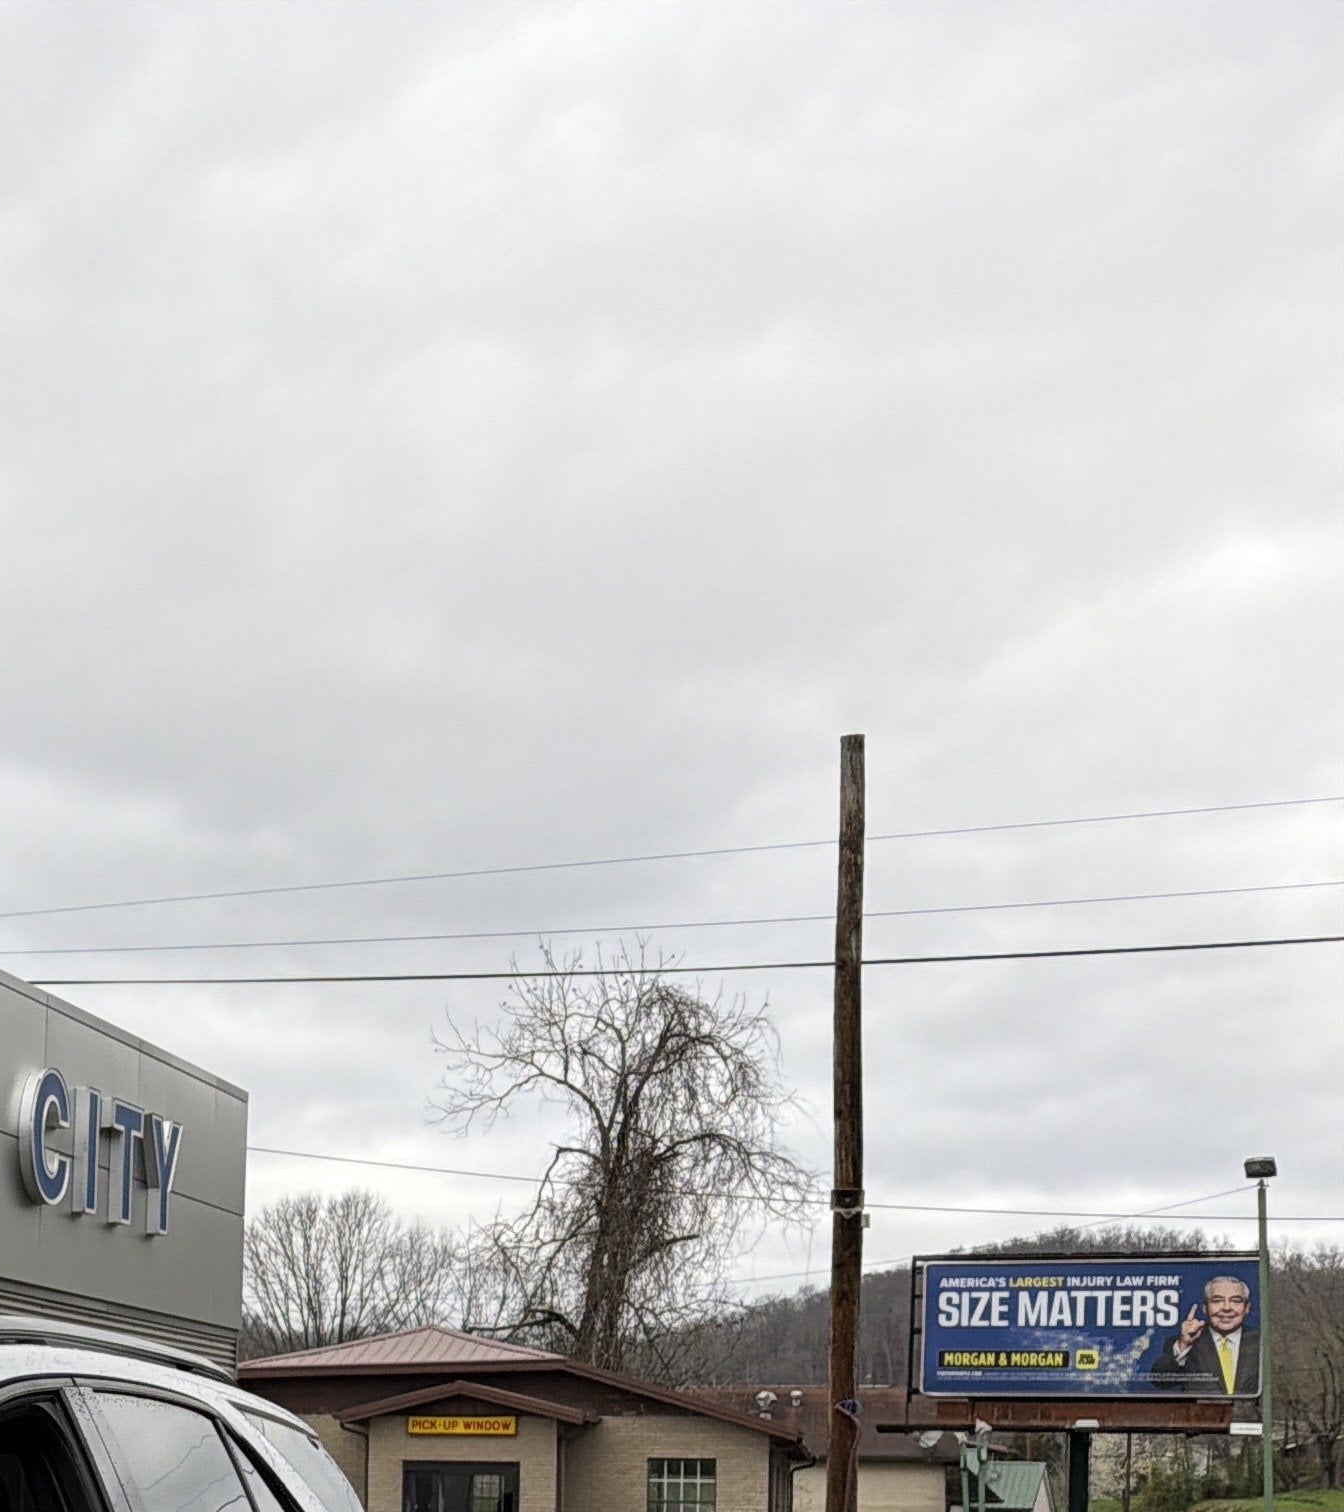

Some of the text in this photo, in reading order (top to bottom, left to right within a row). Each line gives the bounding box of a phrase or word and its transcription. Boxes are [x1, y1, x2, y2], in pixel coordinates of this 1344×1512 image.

[17, 1066, 184, 1237] CITY
[939, 1275, 1180, 1288] AMERICA'S LARGEST INJURY LAW FIRM
[938, 1289, 1180, 1327] SIZE MATTERS
[943, 1352, 996, 1366] MORGAN
[998, 1352, 1008, 1366] &
[1010, 1352, 1064, 1366] MORGAN
[462, 1420, 512, 1431] WINDOW
